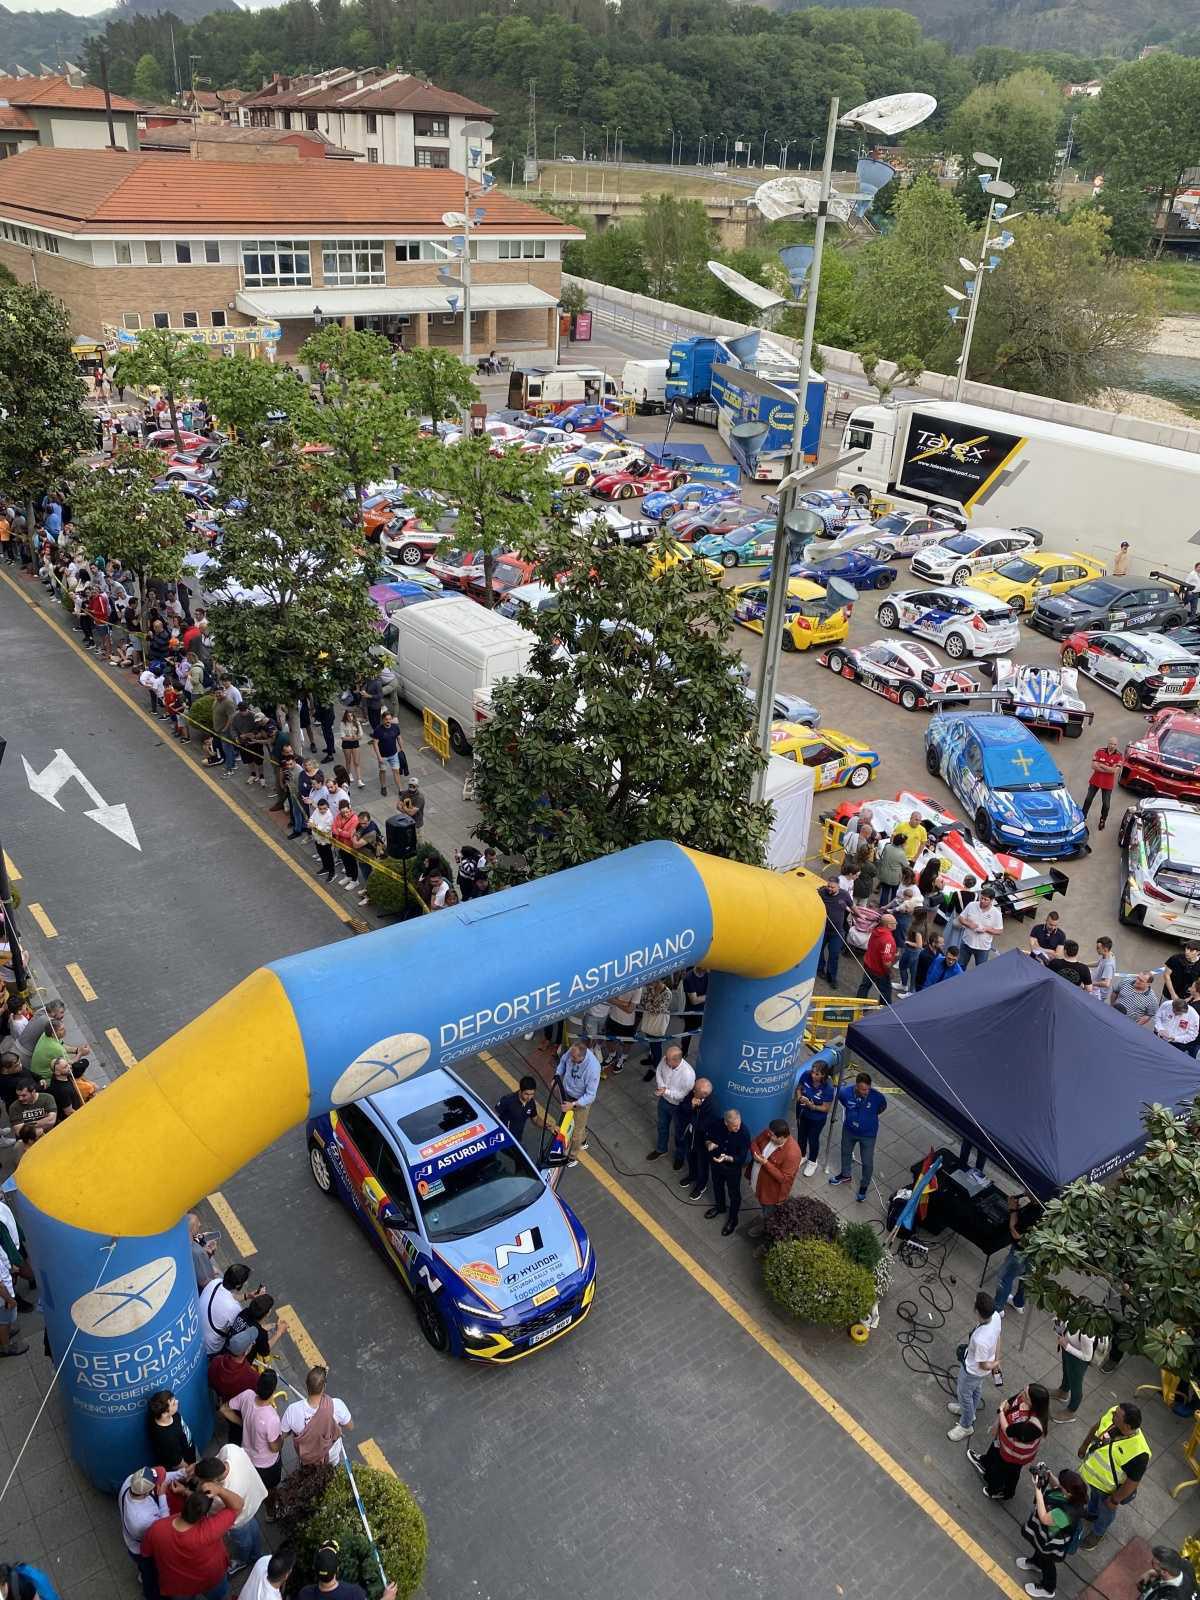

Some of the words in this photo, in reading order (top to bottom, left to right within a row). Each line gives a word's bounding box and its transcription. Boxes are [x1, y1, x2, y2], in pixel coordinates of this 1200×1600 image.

[917, 429, 990, 460] Talex
[440, 982, 562, 1048] DEPORTE
[568, 928, 695, 998] ASTURIANO
[440, 1030, 511, 1064] GOBIERNO
[512, 1021, 534, 1038] DEL
[537, 989, 609, 1026] PRINCIPADO
[609, 983, 626, 996] DE
[630, 959, 687, 986] ASTURIAS
[437, 1140, 487, 1170] ASTURDAI
[520, 1253, 559, 1278] HYUNDAI
[72, 1302, 196, 1371] DEPORTE
[77, 1313, 199, 1388] ASTURIANO
[98, 1374, 169, 1402] GOBIERNO
[170, 1357, 188, 1377] DEL
